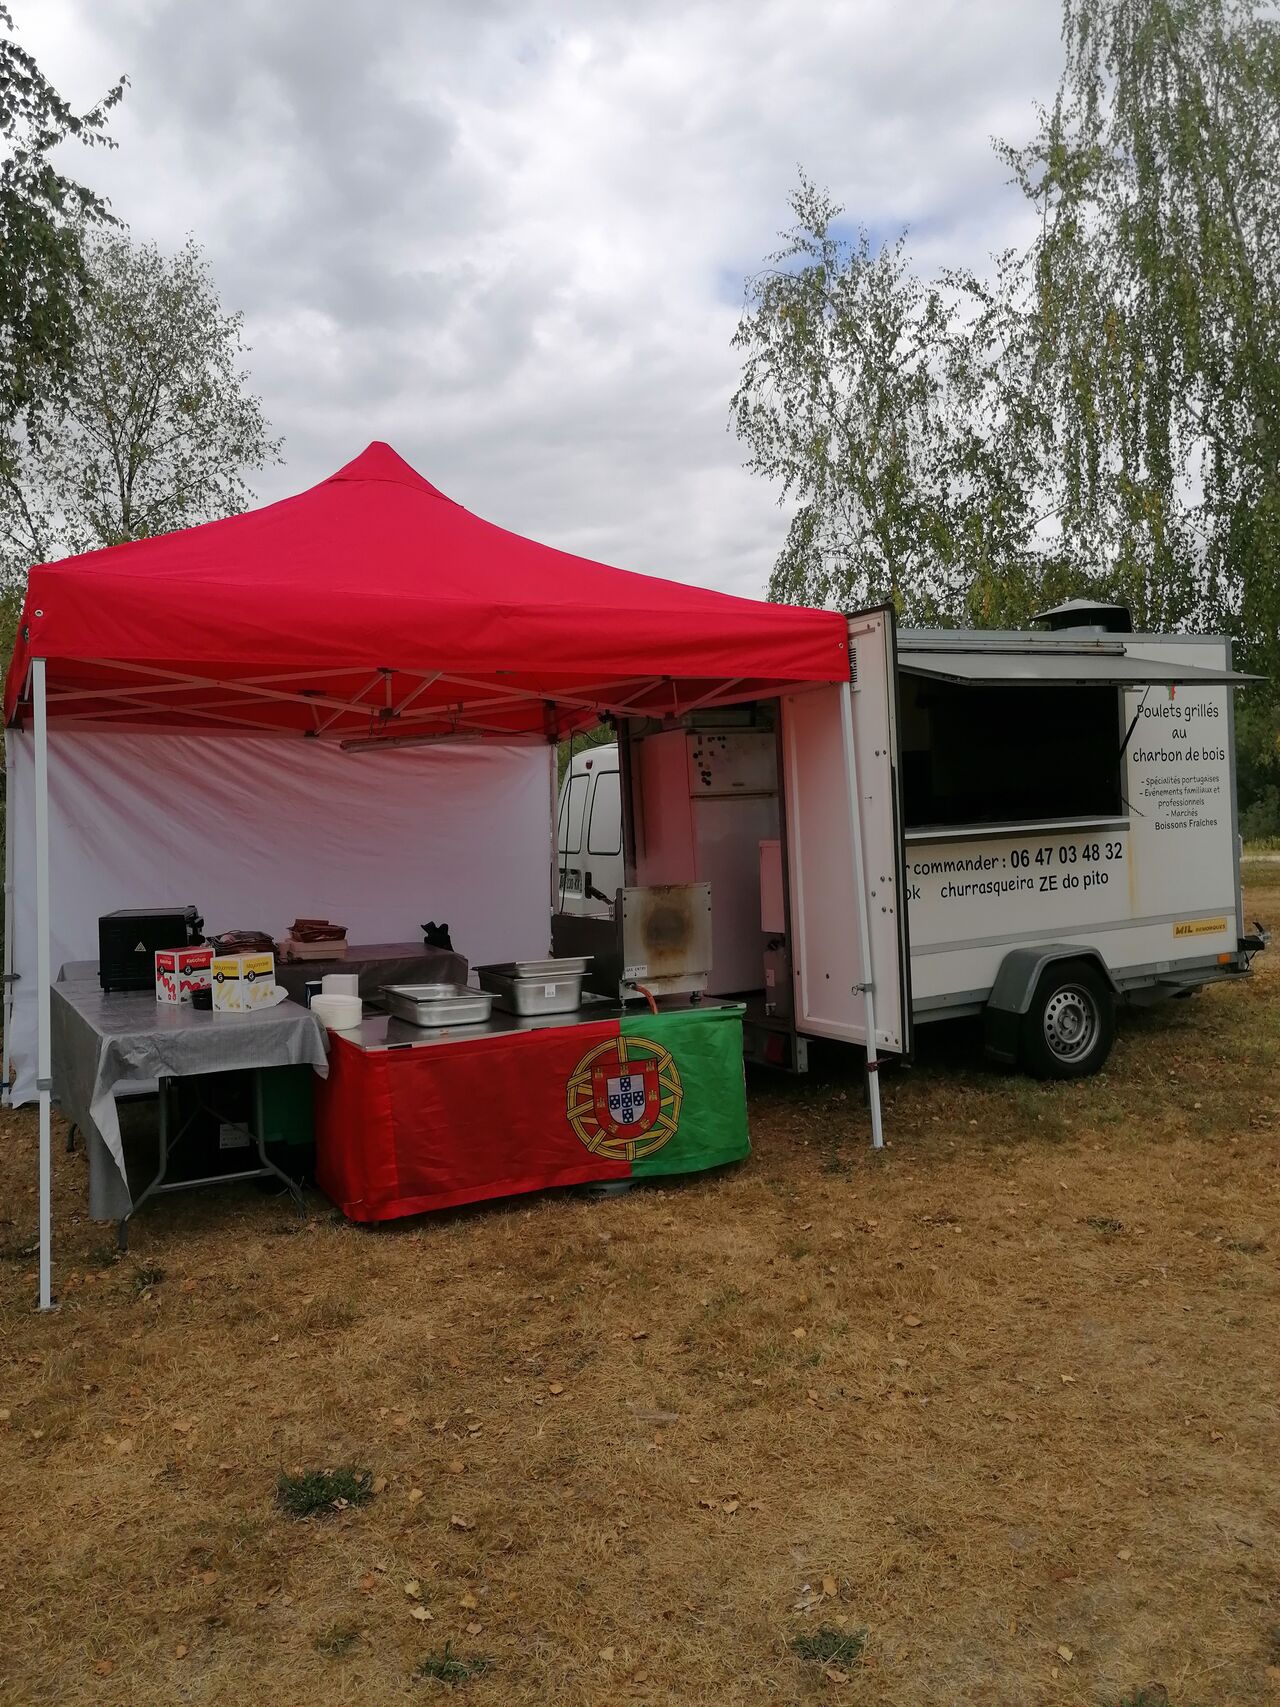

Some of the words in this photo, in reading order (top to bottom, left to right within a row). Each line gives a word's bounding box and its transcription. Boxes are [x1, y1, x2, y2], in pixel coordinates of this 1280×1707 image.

[1137, 703, 1182, 718] Poulets
[1185, 702, 1219, 721] grillés
[1172, 728, 1187, 739] au
[1133, 748, 1183, 762] charbon
[1185, 747, 1200, 761] de
[1202, 747, 1225, 761] bois
[1146, 776, 1181, 787] Spécialités
[1182, 775, 1220, 785] portugaises
[1184, 786, 1212, 794] familiaux
[1158, 798, 1205, 809] professionnels
[1171, 808, 1198, 817] Marchés
[1154, 821, 1187, 830] Boissons
[913, 855, 1000, 875] commander
[1010, 849, 1030, 868] 06
[1035, 847, 1053, 866] 47
[1059, 845, 1077, 864] 03
[1082, 844, 1100, 861] 48
[1105, 842, 1122, 860] 32
[940, 876, 1034, 898] churrasqueira
[1039, 875, 1058, 892] ZE
[1062, 873, 1079, 889] do
[1083, 870, 1109, 890] pito
[1175, 925, 1193, 935] MIL
